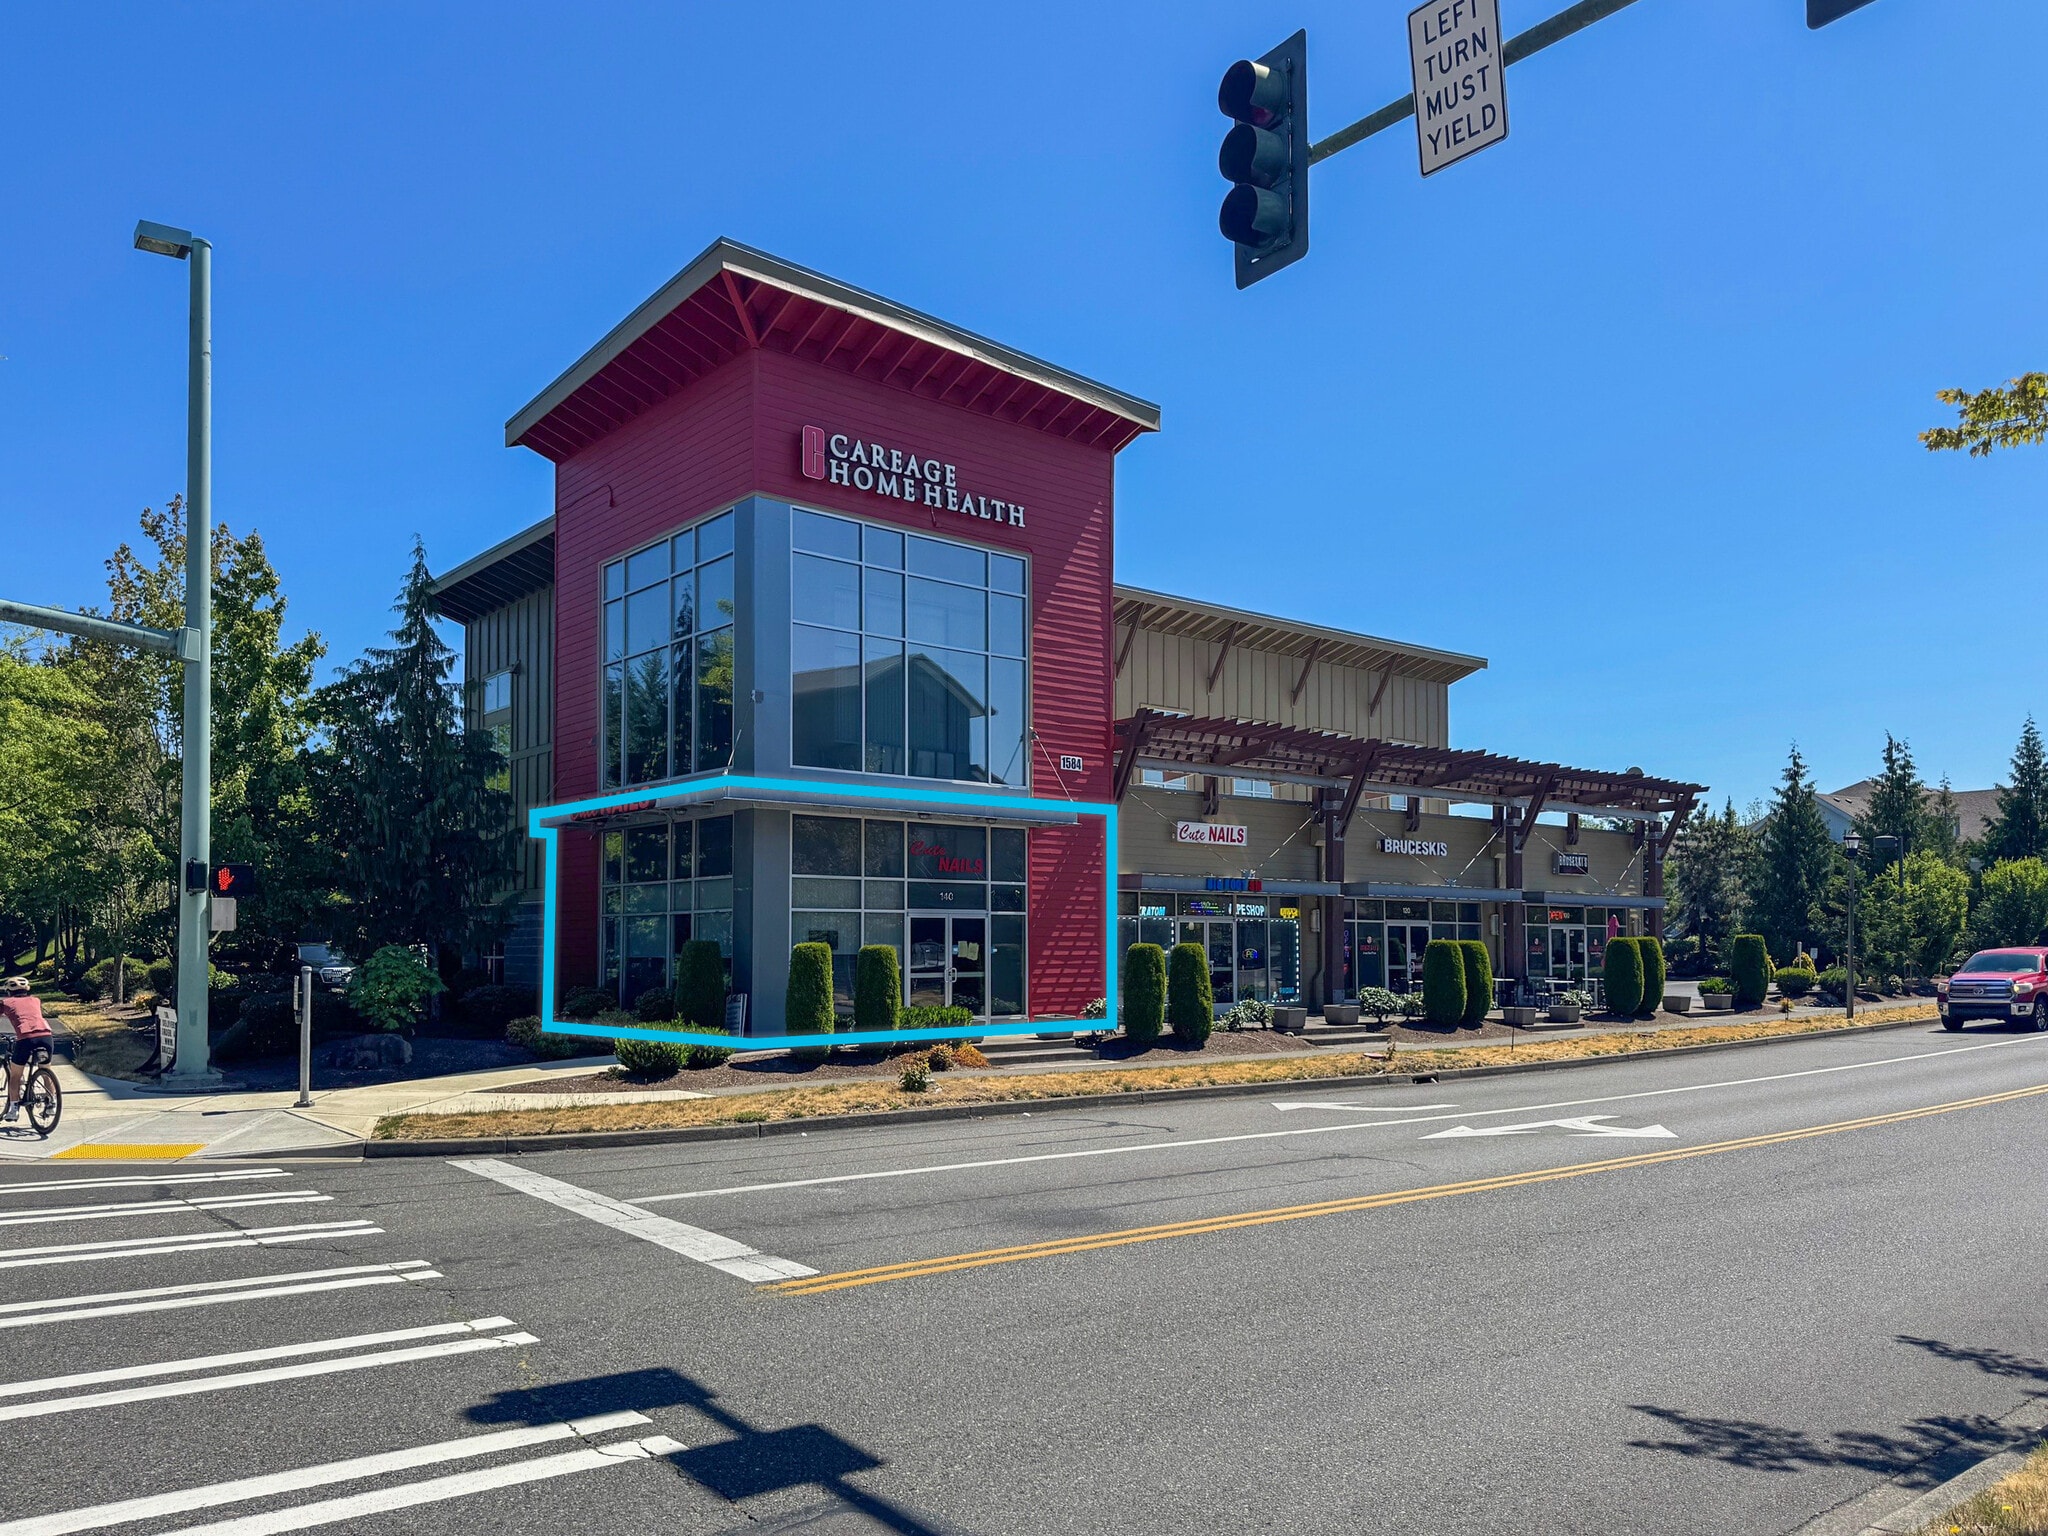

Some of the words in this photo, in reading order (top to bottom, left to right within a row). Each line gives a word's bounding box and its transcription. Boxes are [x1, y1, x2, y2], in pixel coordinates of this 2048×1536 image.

[1424, 26, 1487, 82] TURN
[1426, 65, 1489, 121] MUST
[1427, 103, 1496, 155] YIELD
[829, 434, 956, 488] CAREAGE
[829, 459, 915, 502] HOME
[923, 482, 1026, 528] HEALTH
[1062, 757, 1082, 770] 1584
[911, 840, 946, 856] Cute
[1179, 824, 1206, 841] Cute
[1208, 826, 1244, 843] NAILS
[938, 857, 984, 873] NAILS
[940, 892, 954, 901] 140
